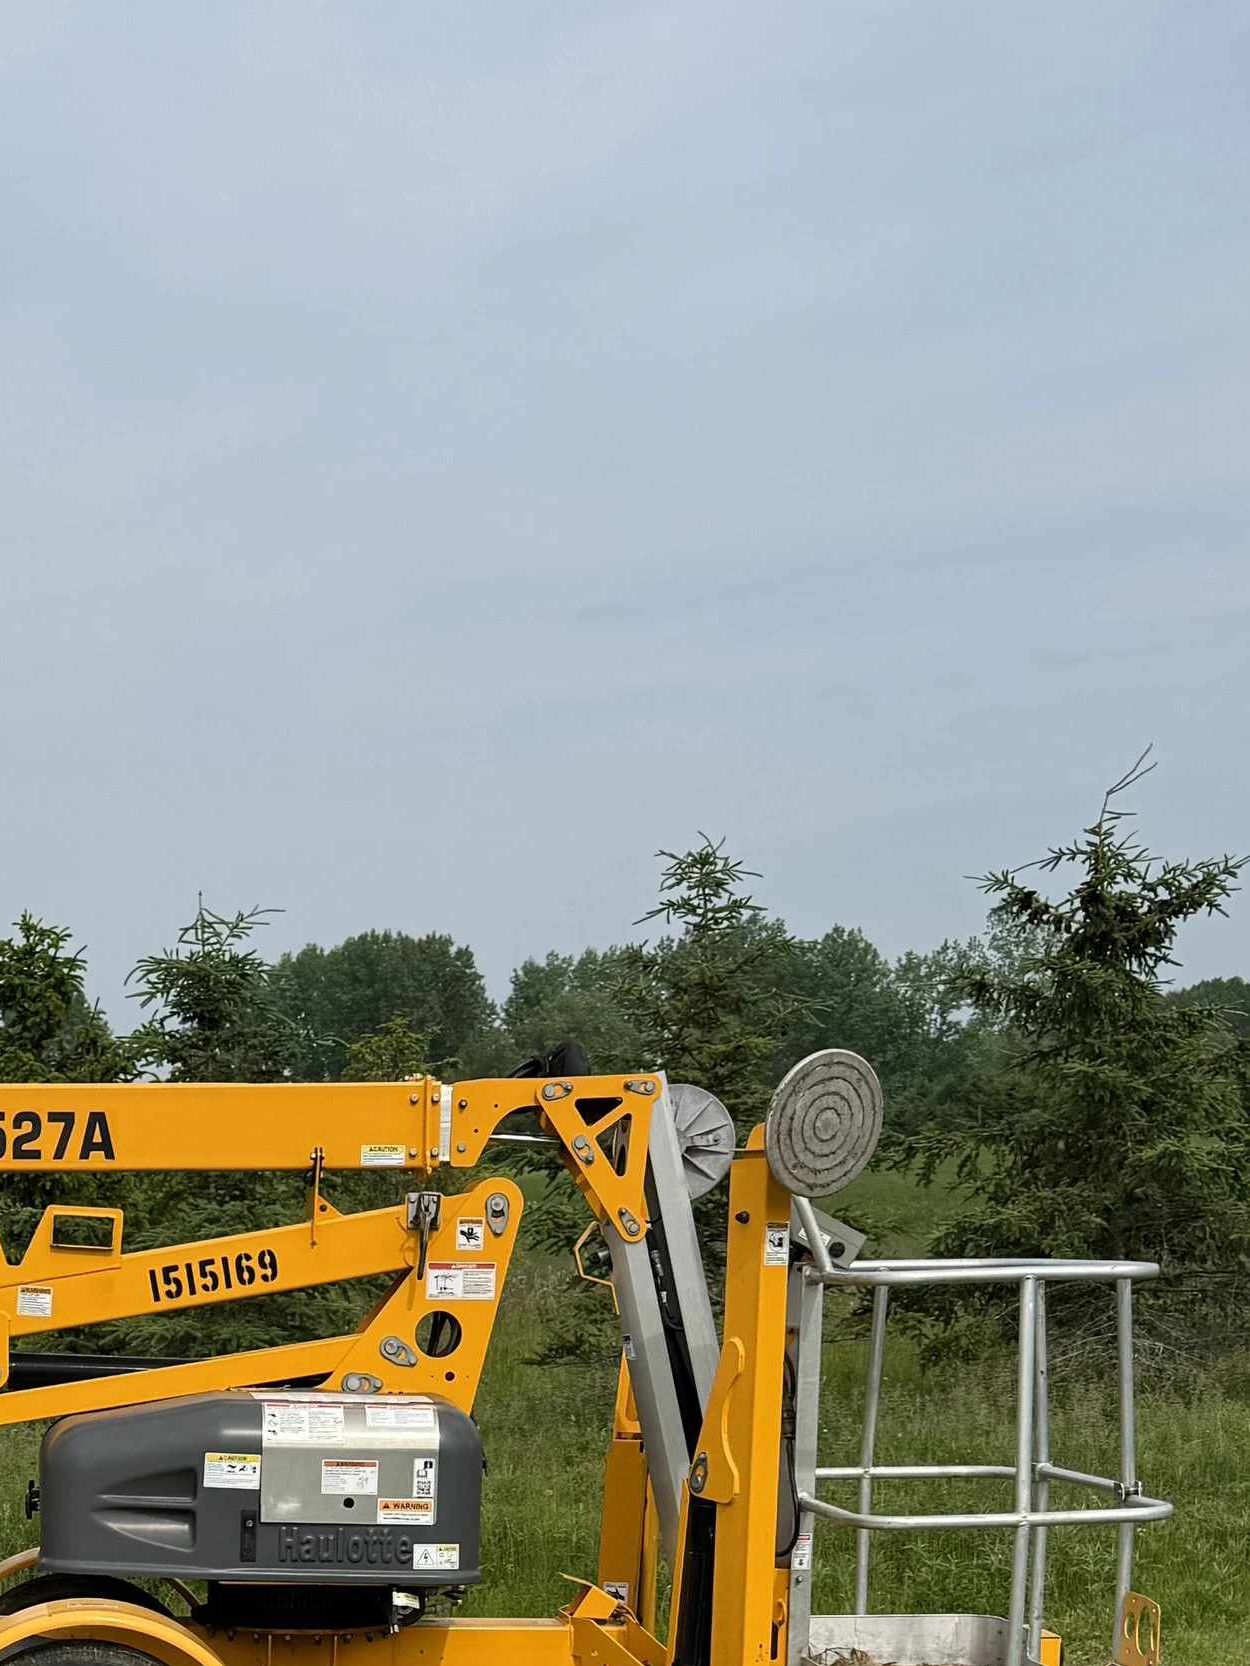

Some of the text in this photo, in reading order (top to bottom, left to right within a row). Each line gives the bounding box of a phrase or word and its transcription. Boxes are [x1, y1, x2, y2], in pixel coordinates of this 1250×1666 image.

[148, 1249, 278, 1302] 1515169
[392, 1502, 430, 1511] WARNING
[278, 1526, 414, 1564] Haulotte
